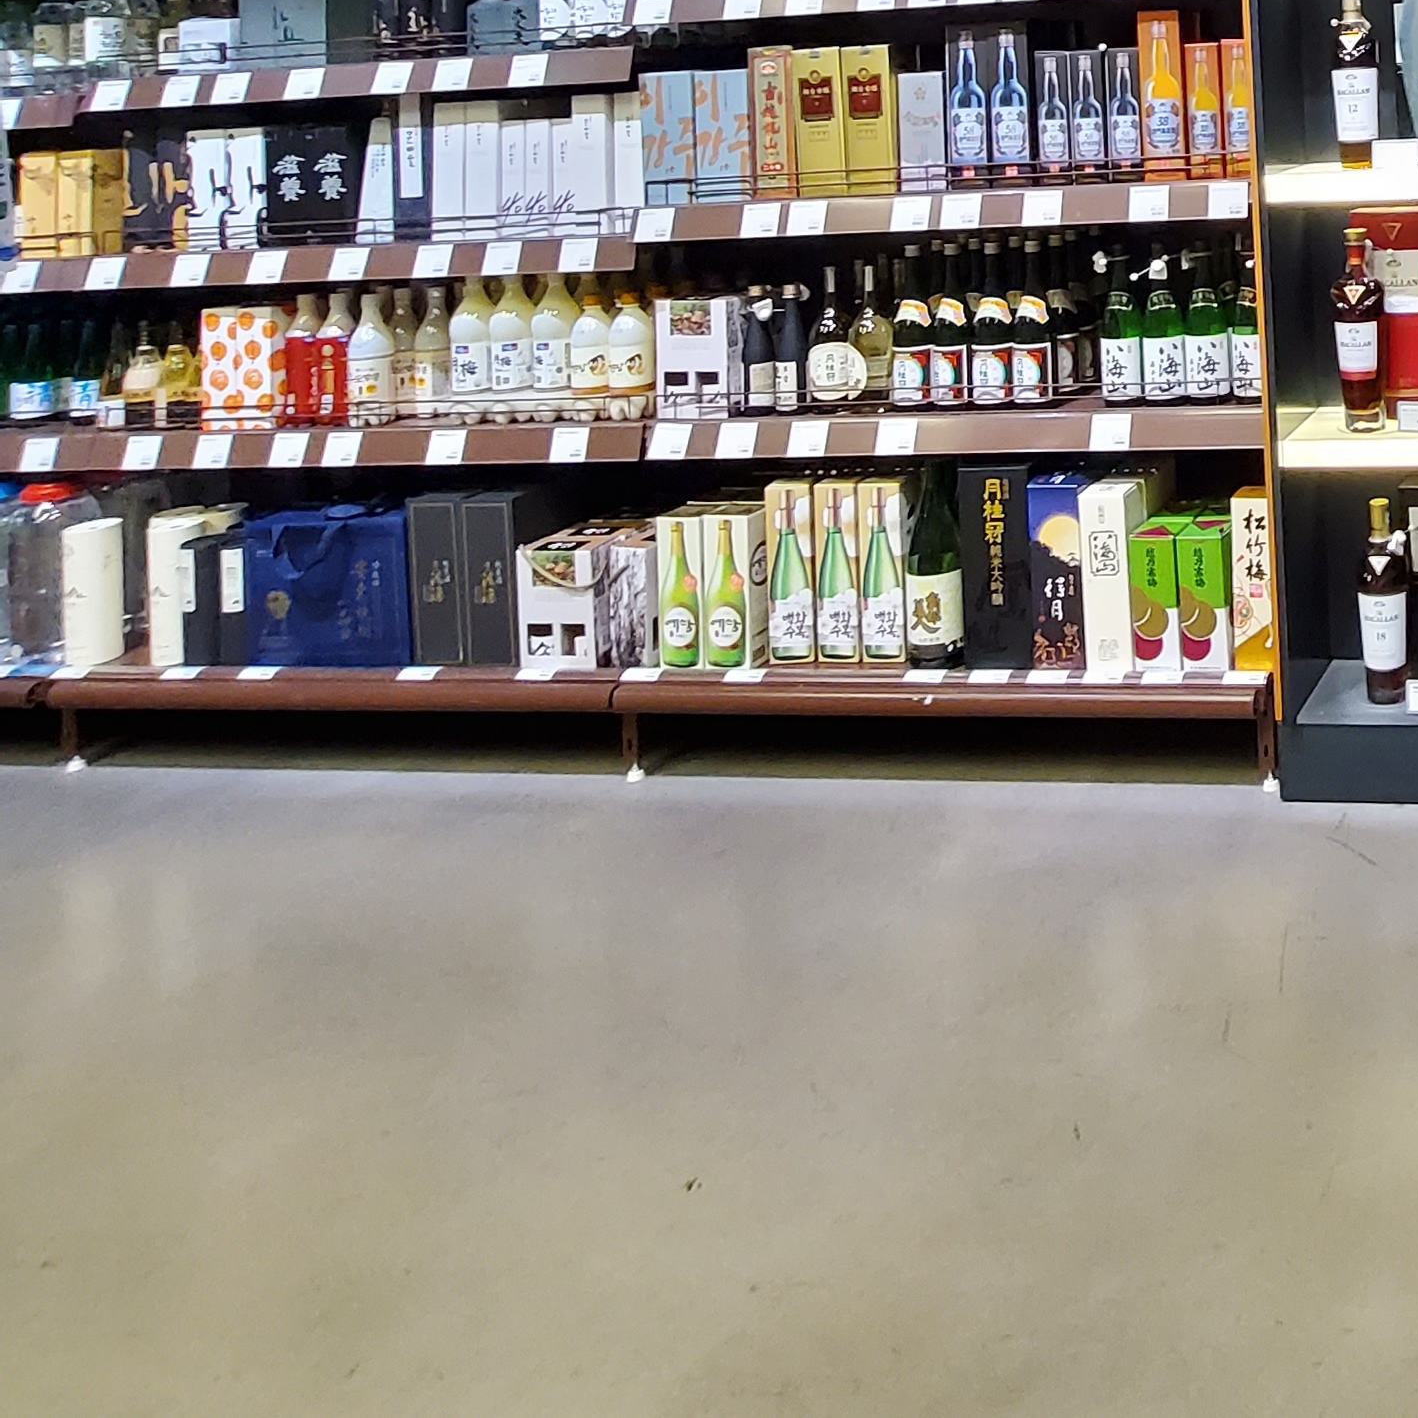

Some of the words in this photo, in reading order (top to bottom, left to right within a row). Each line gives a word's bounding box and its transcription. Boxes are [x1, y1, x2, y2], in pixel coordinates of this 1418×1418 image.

[1348, 104, 1359, 114] 12
[1384, 278, 1418, 287] CALLAN
[982, 478, 1005, 543] 月桂冠
[1242, 509, 1268, 581] 松竹梅
[1376, 631, 1387, 641] 18
